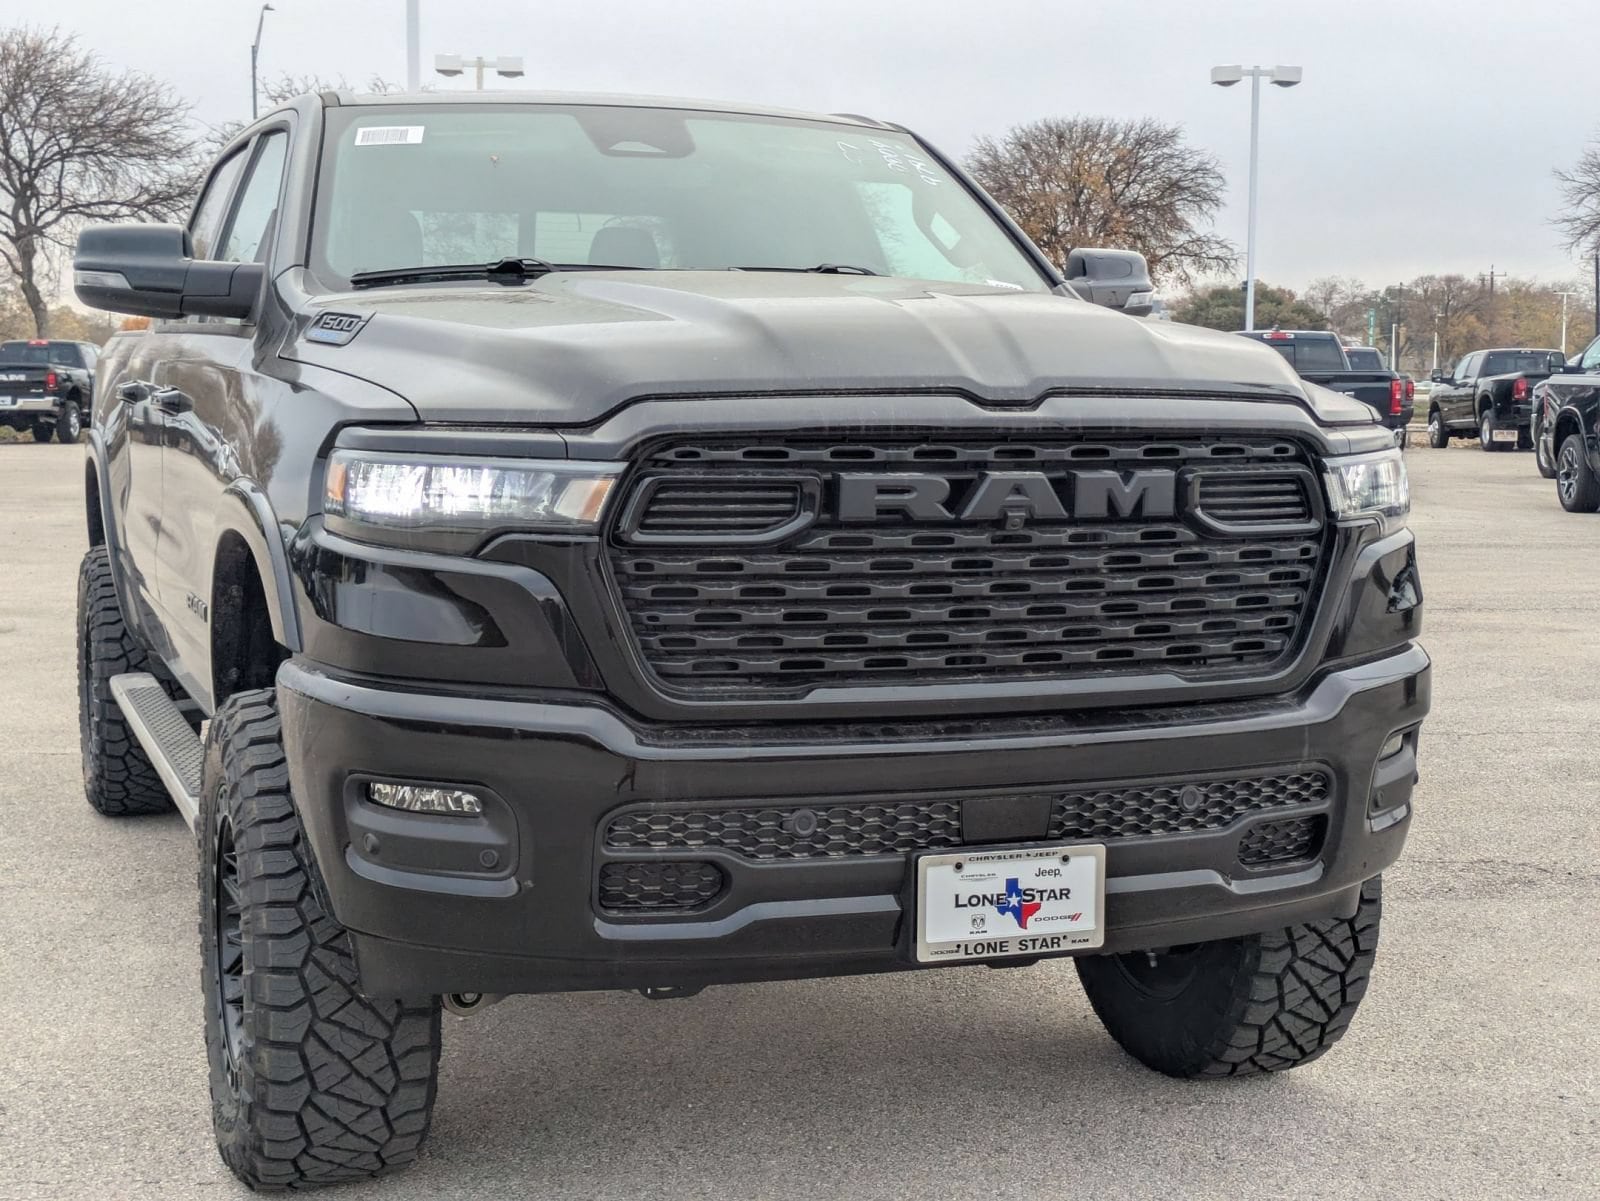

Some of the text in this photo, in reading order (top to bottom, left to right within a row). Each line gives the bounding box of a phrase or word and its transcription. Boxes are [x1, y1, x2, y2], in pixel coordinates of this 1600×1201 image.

[320, 315, 360, 331] 1500
[833, 470, 1176, 520] RAM
[968, 853, 1022, 862] CHRYSLER
[1034, 867, 1061, 878] Jeep
[954, 888, 1071, 908] LONE STAR
[964, 941, 1009, 956] LONE
[1018, 936, 1061, 951] STAR
